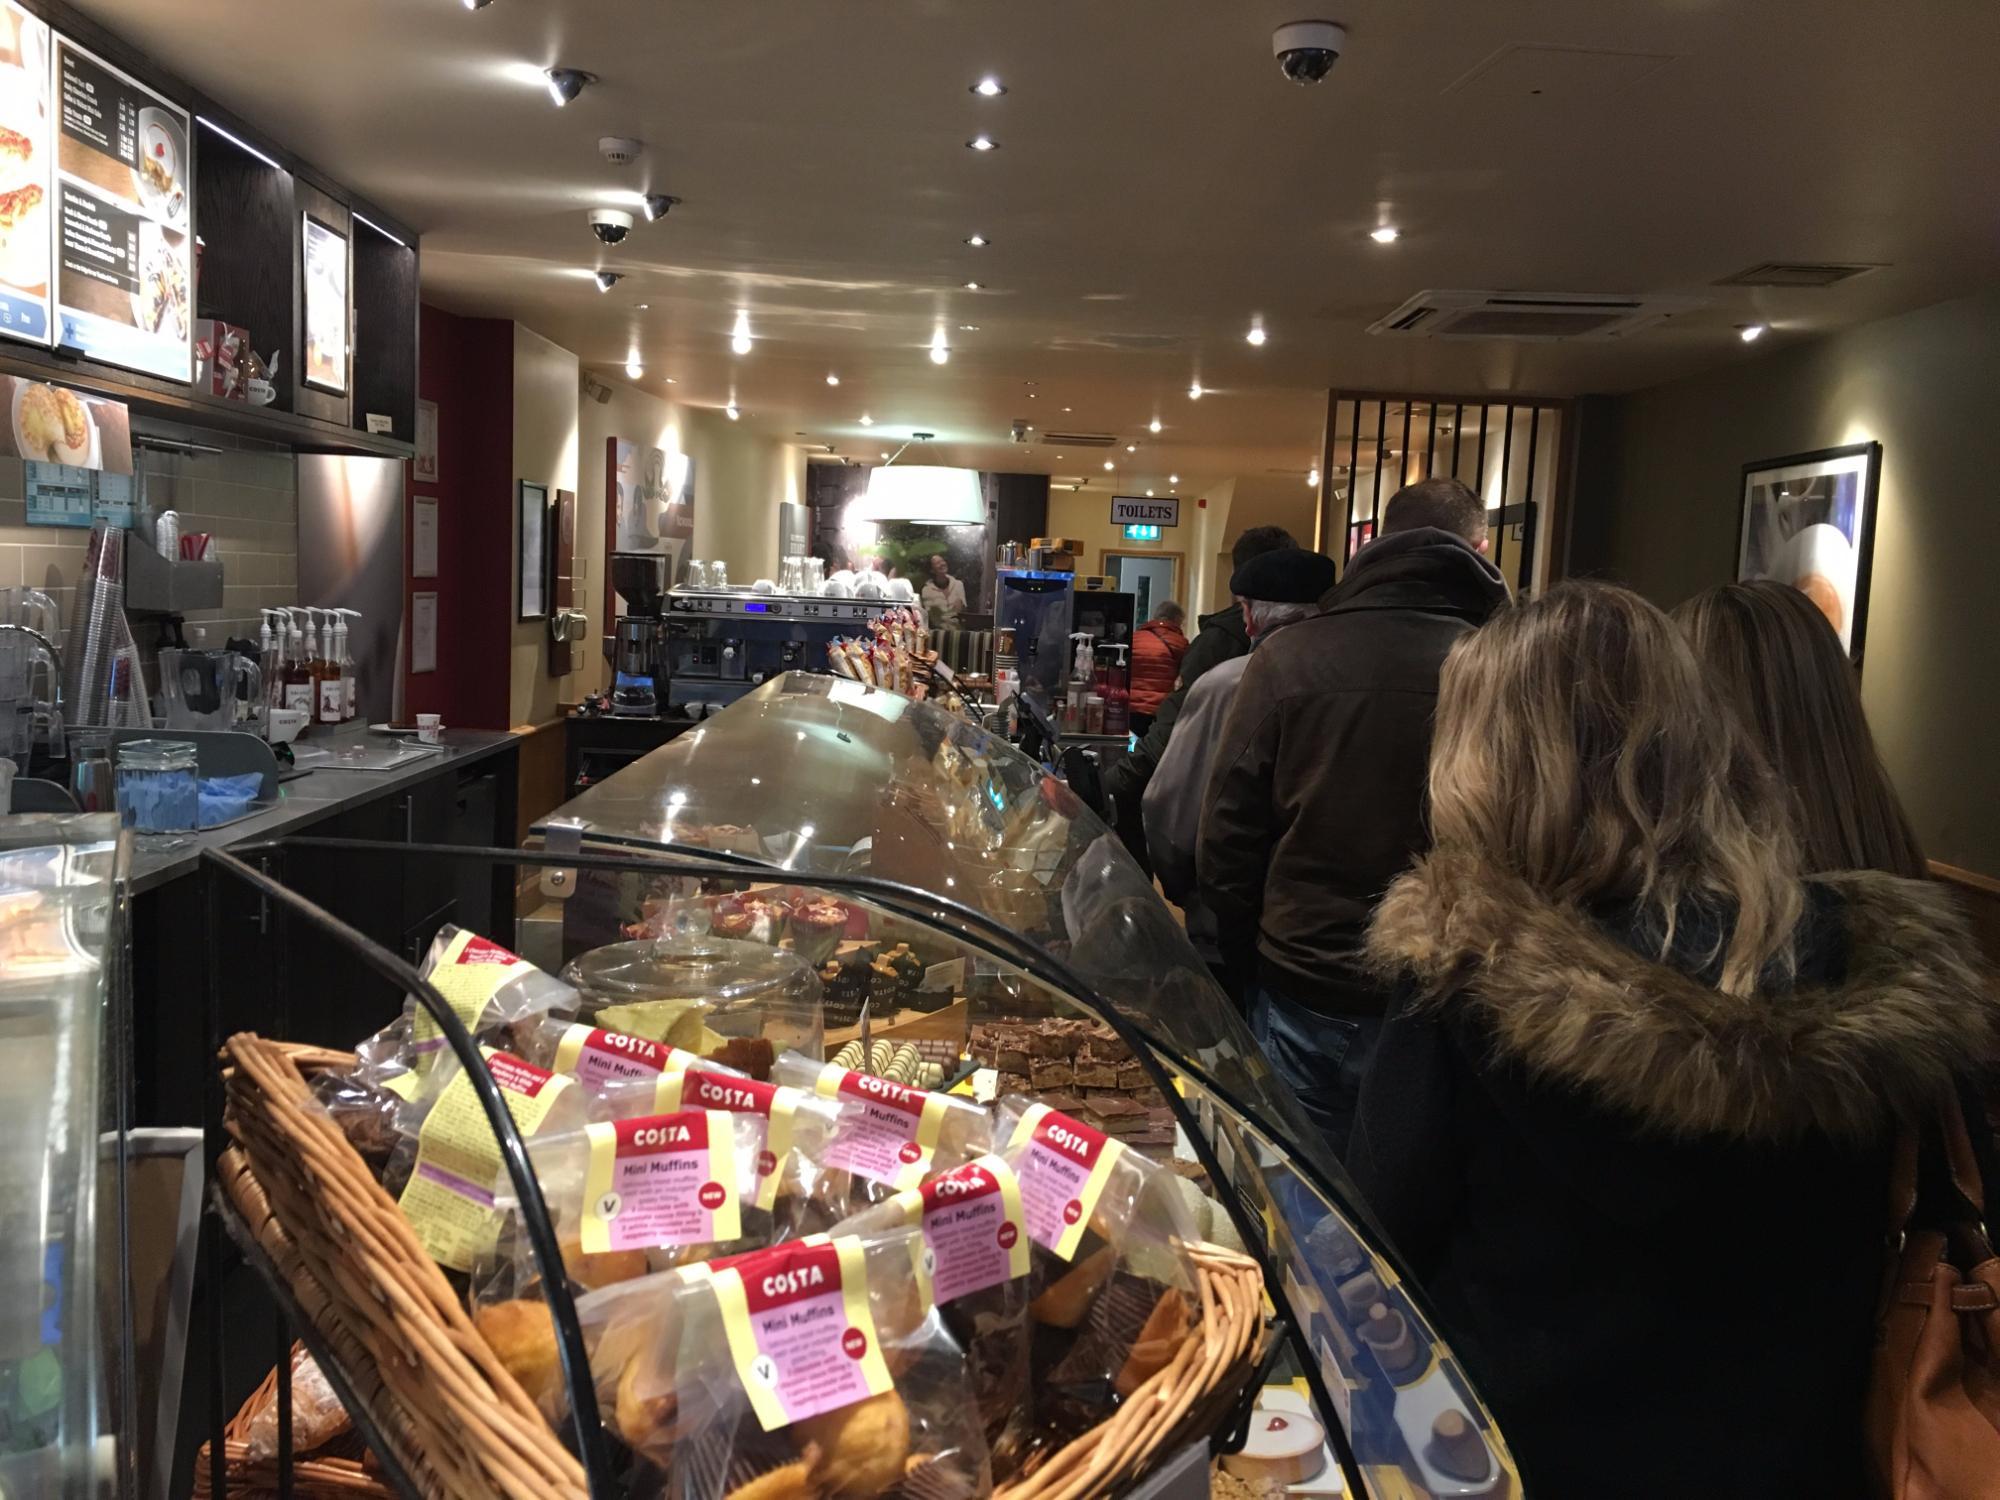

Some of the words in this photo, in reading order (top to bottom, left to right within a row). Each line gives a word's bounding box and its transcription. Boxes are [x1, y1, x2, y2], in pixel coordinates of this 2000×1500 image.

[1117, 504, 1172, 519] TOILETS
[604, 1033, 656, 1058] COSTA
[588, 1055, 611, 1071] Mini
[614, 1064, 646, 1078] Muffi
[700, 1083, 755, 1107] COSTA
[858, 1076, 910, 1103] COSTA
[870, 1108, 909, 1129] Muffins
[634, 1125, 691, 1147] COSTA
[1047, 1124, 1089, 1158] COSTA
[623, 1164, 648, 1176] Mini
[650, 1160, 698, 1173] Muffins
[1030, 1148, 1049, 1166] Mini
[1049, 1158, 1080, 1184] Muffins
[930, 1213, 953, 1229] Mini
[955, 1203, 996, 1221] Muffins
[763, 1265, 824, 1297] COSTA
[762, 1317, 788, 1334] Mini
[790, 1306, 835, 1326] Muffins
